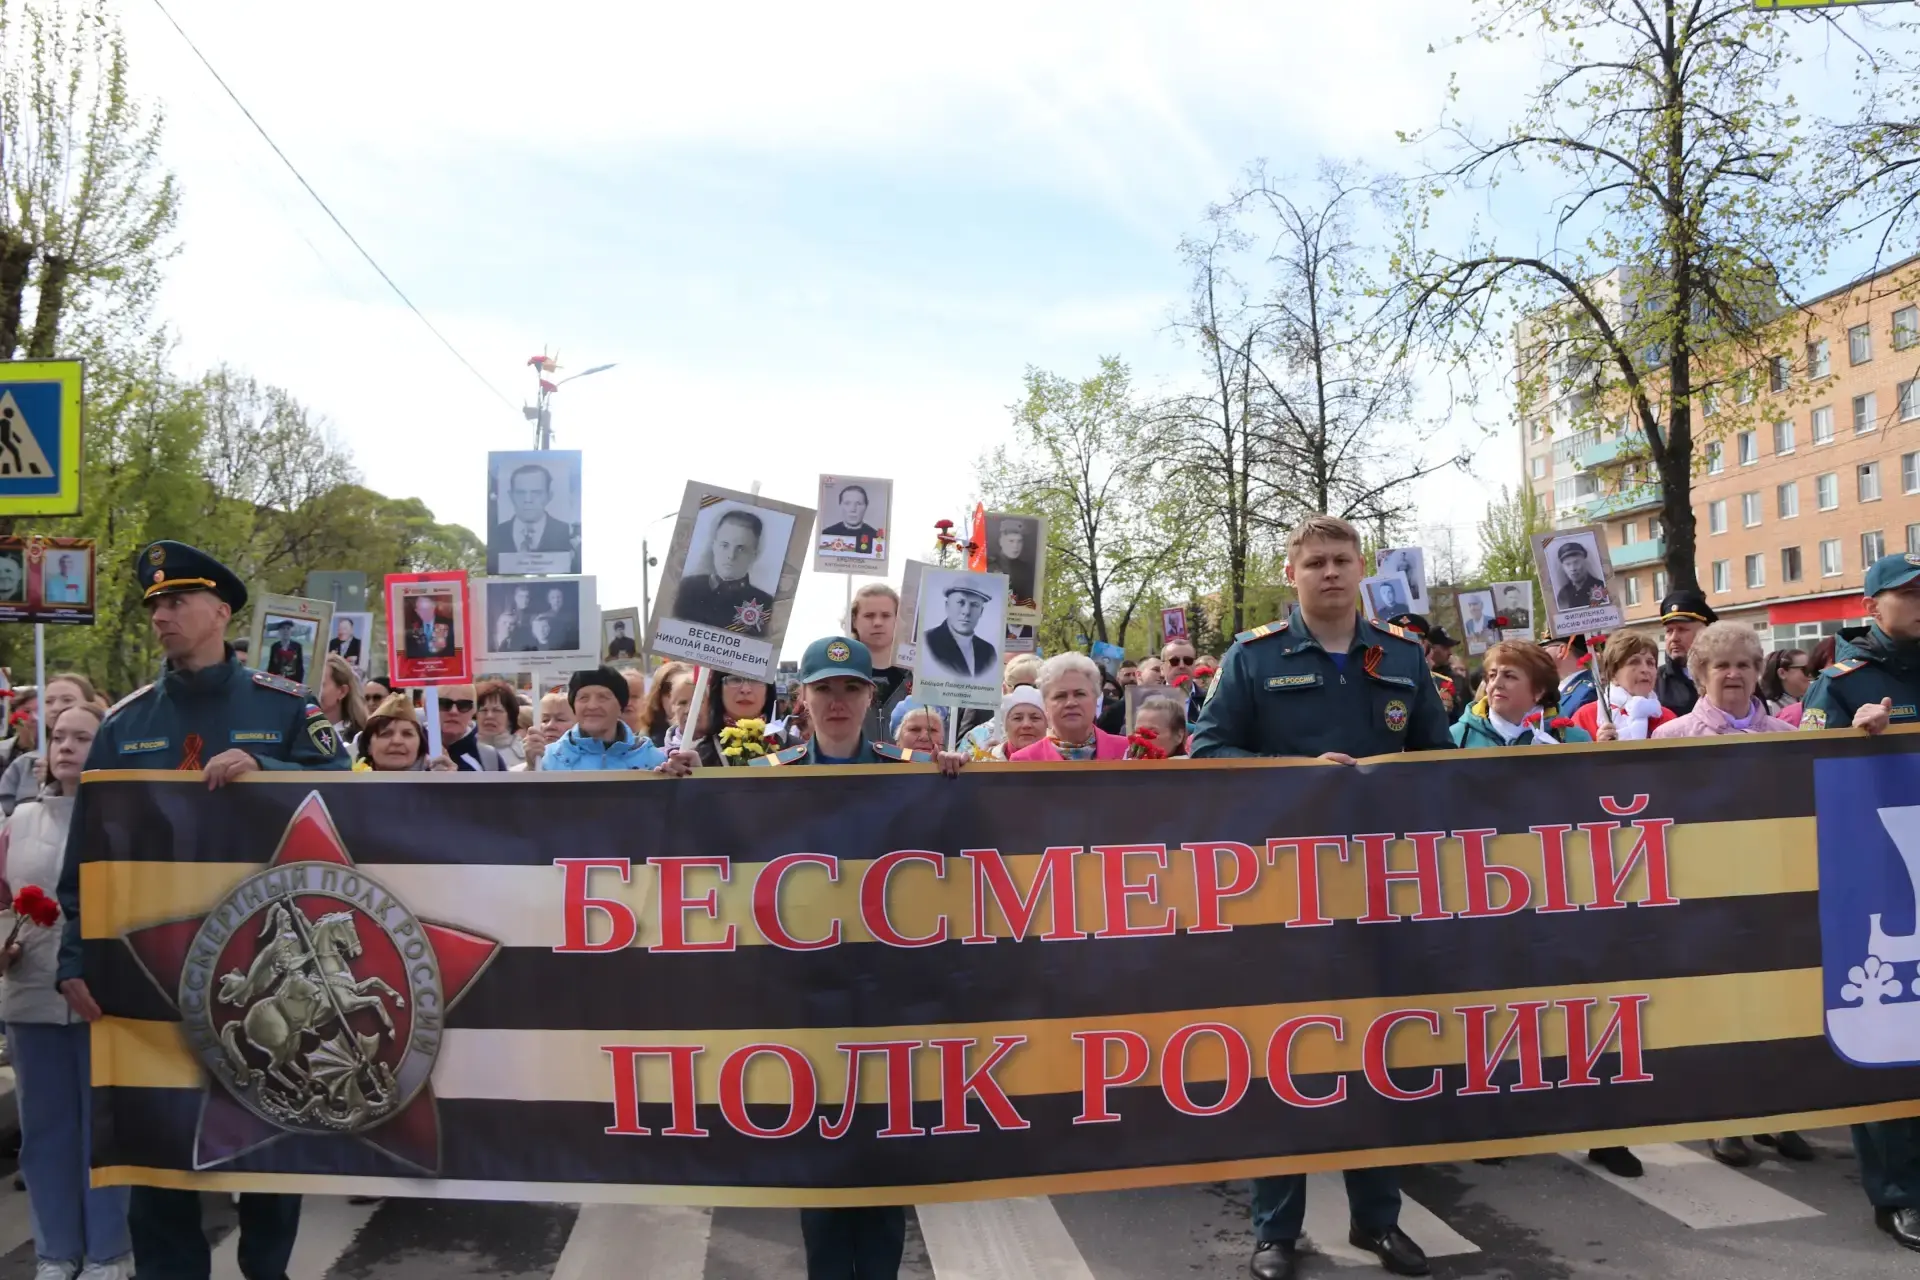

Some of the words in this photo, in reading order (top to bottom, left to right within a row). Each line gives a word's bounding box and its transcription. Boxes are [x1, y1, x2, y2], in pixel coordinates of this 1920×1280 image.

[1557, 621, 1581, 630] ИОСИФ
[1582, 615, 1618, 626] КЛИМОВИЧ
[1565, 609, 1605, 620] ФИЛИПЕНКО
[655, 632, 701, 650] НИКОЛАЙ
[703, 643, 769, 667] ВАСИЛЬЕВИЧ
[688, 627, 741, 648] ВЕСЕЛОВ
[1270, 678, 1285, 686] МЧС
[1286, 675, 1314, 684] РОССИИ
[553, 794, 1680, 953] БЕССМЕРТНЫЙ
[184, 865, 308, 1053] БЕССМЕРТНЫЙ
[321, 868, 397, 920] ПОЛК
[392, 918, 441, 1056] РОССИИ
[600, 1034, 1032, 1140] ПОЛК
[1071, 993, 1654, 1124] РОССИИ
